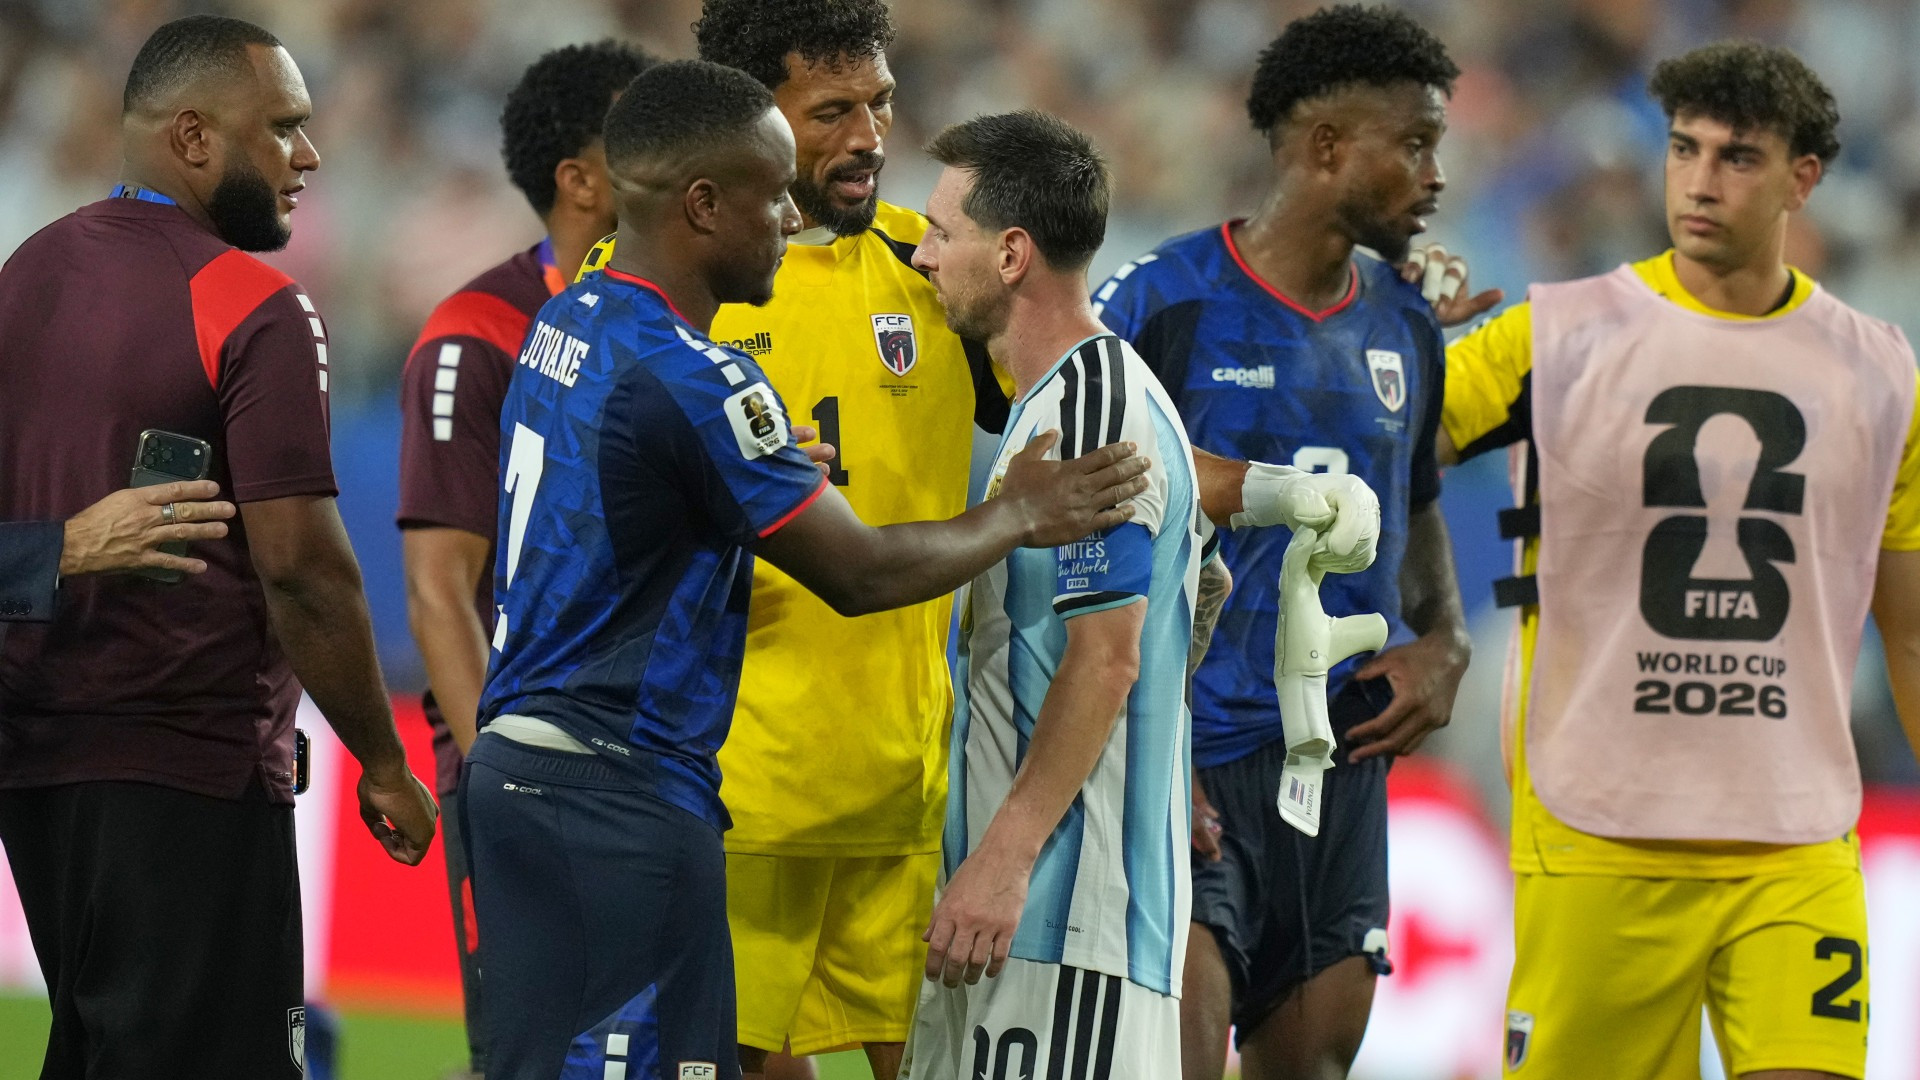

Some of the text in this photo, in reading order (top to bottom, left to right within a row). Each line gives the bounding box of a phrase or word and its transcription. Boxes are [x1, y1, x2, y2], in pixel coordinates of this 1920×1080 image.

[875, 316, 908, 326] FCF
[520, 320, 590, 388] JOVANE
[1212, 365, 1275, 386] capelli
[812, 396, 849, 487] 1
[492, 421, 545, 653] 7
[1059, 541, 1106, 562] UNITES
[1058, 559, 1110, 578] the World
[1068, 579, 1088, 589] FIFA
[1684, 590, 1760, 620] FIFA
[1636, 652, 1787, 678] WORLD CUP
[1634, 679, 1787, 720] 2026
[1811, 936, 1870, 1023] 2
[682, 1065, 713, 1077] FCF
